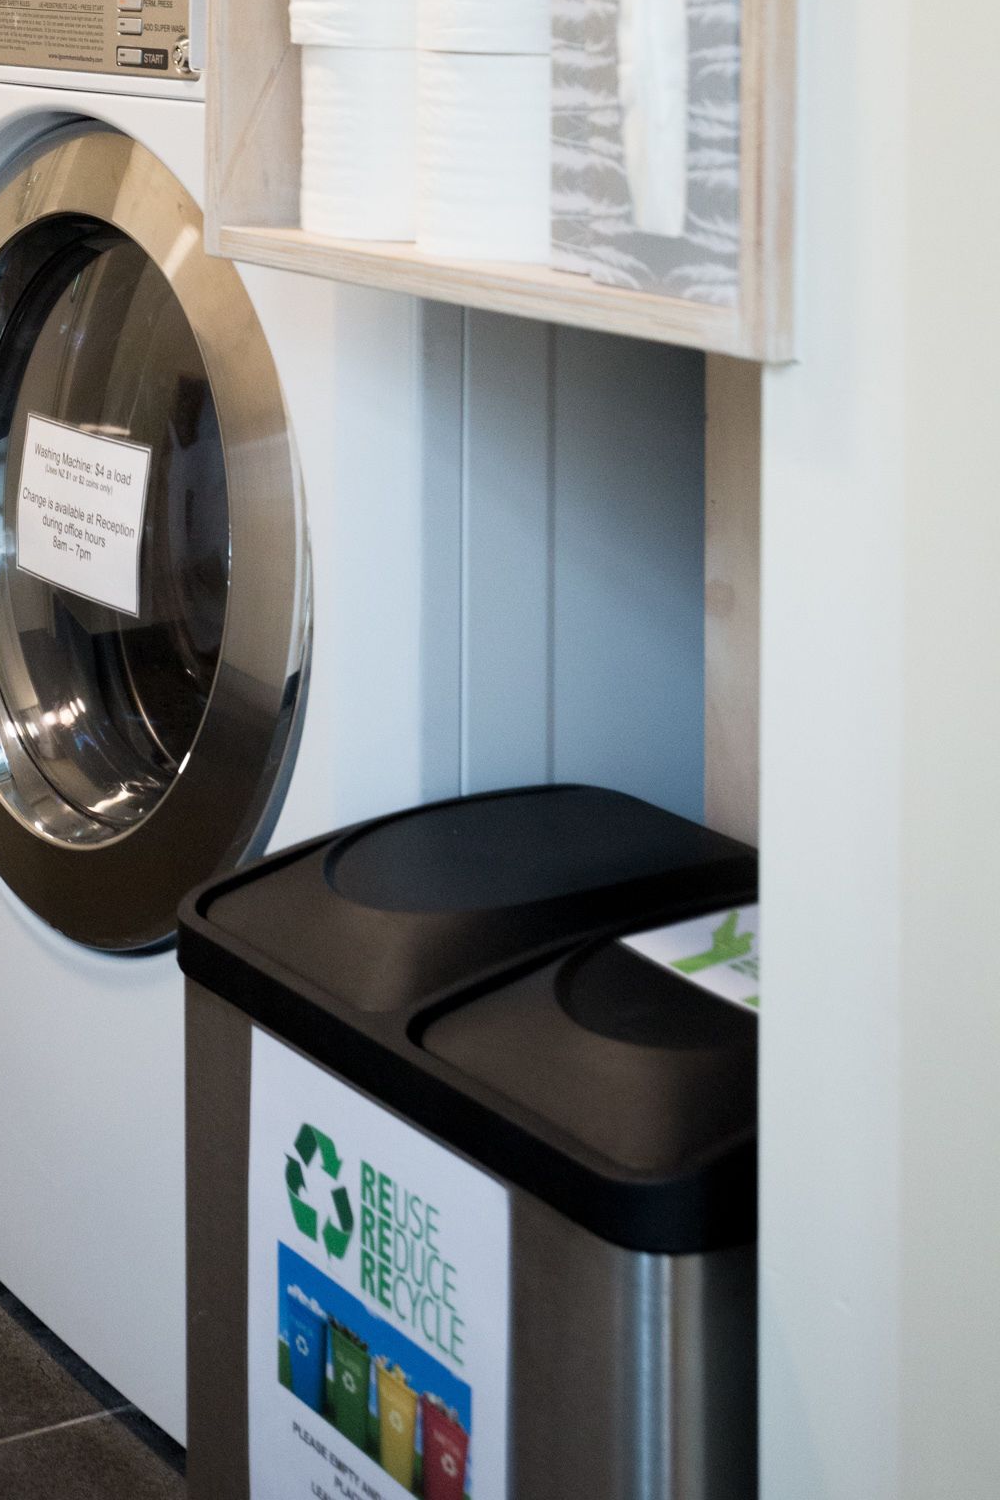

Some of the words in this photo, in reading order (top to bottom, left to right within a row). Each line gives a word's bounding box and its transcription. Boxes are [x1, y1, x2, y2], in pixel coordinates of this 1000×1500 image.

[157, 0, 173, 9] PRESS
[154, 23, 171, 32] SUPER
[171, 24, 185, 33] WASH
[143, 53, 164, 64] START
[34, 444, 61, 466] Washing
[62, 452, 92, 473] Machine:
[95, 463, 105, 477] $4
[107, 470, 111, 480] a
[114, 470, 131, 486] load
[59, 468, 65, 478] NZ
[66, 470, 71, 480] $1
[79, 475, 85, 484] $2
[86, 479, 99, 490] coins
[100, 483, 113, 495] only)
[22, 487, 46, 508] Change
[48, 499, 53, 509] is
[55, 501, 85, 521] available
[86, 512, 94, 524] at
[95, 514, 135, 538] Reception
[42, 514, 62, 535] during
[64, 522, 82, 540] office
[85, 529, 106, 548] hours
[53, 535, 67, 552] 8am
[75, 544, 91, 561] 7pm
[360, 1158, 441, 1253] REUSE
[360, 1202, 457, 1311] REDUCE
[360, 1247, 465, 1367] RECYCLE
[292, 1420, 327, 1460] PLEASE
[328, 1451, 360, 1485] EMPTY
